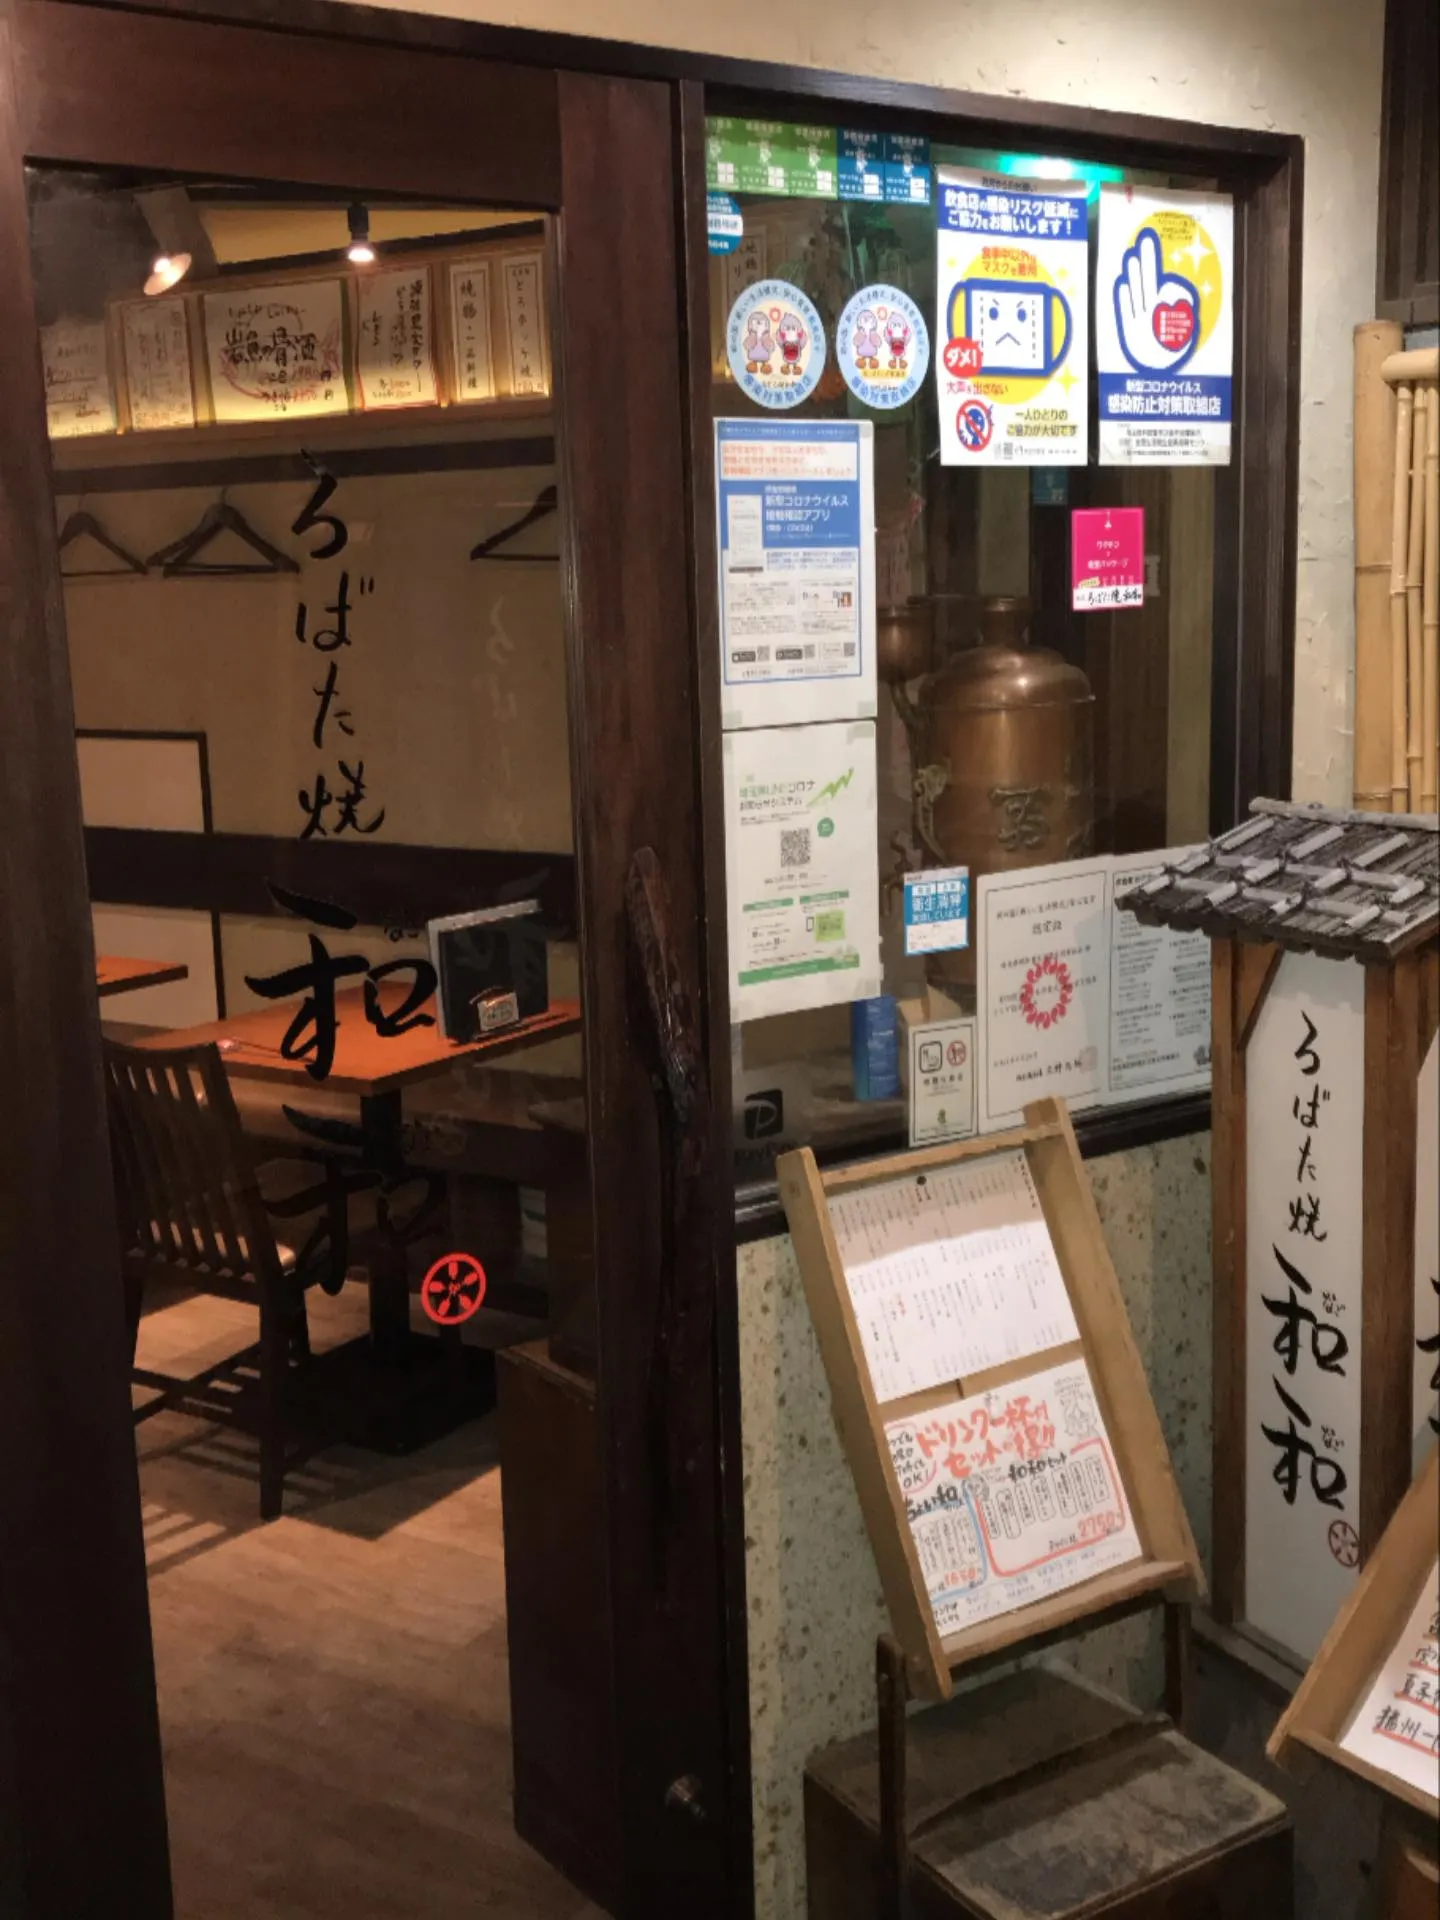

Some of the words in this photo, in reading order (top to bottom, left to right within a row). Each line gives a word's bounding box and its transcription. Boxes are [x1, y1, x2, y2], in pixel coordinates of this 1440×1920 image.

[945, 190, 1079, 218] 飲食店の感染リスク低減に
[948, 210, 1072, 235] ご協力をお願いします！
[982, 261, 1037, 277] マスクを着用
[946, 380, 1009, 395] 大声を出さない
[1126, 379, 1202, 394] 新型コロナウイルス
[1107, 393, 1221, 416] 感染防止対策取組店
[1015, 408, 1068, 421] 一人ひとりの
[1007, 423, 1078, 437] ご協力が大切です
[765, 495, 849, 507] 新型コロナウイルス
[766, 509, 830, 521] 接触確認アプリ
[292, 448, 386, 839] ろばた焼
[1288, 1010, 1330, 1242] ろばた焼
